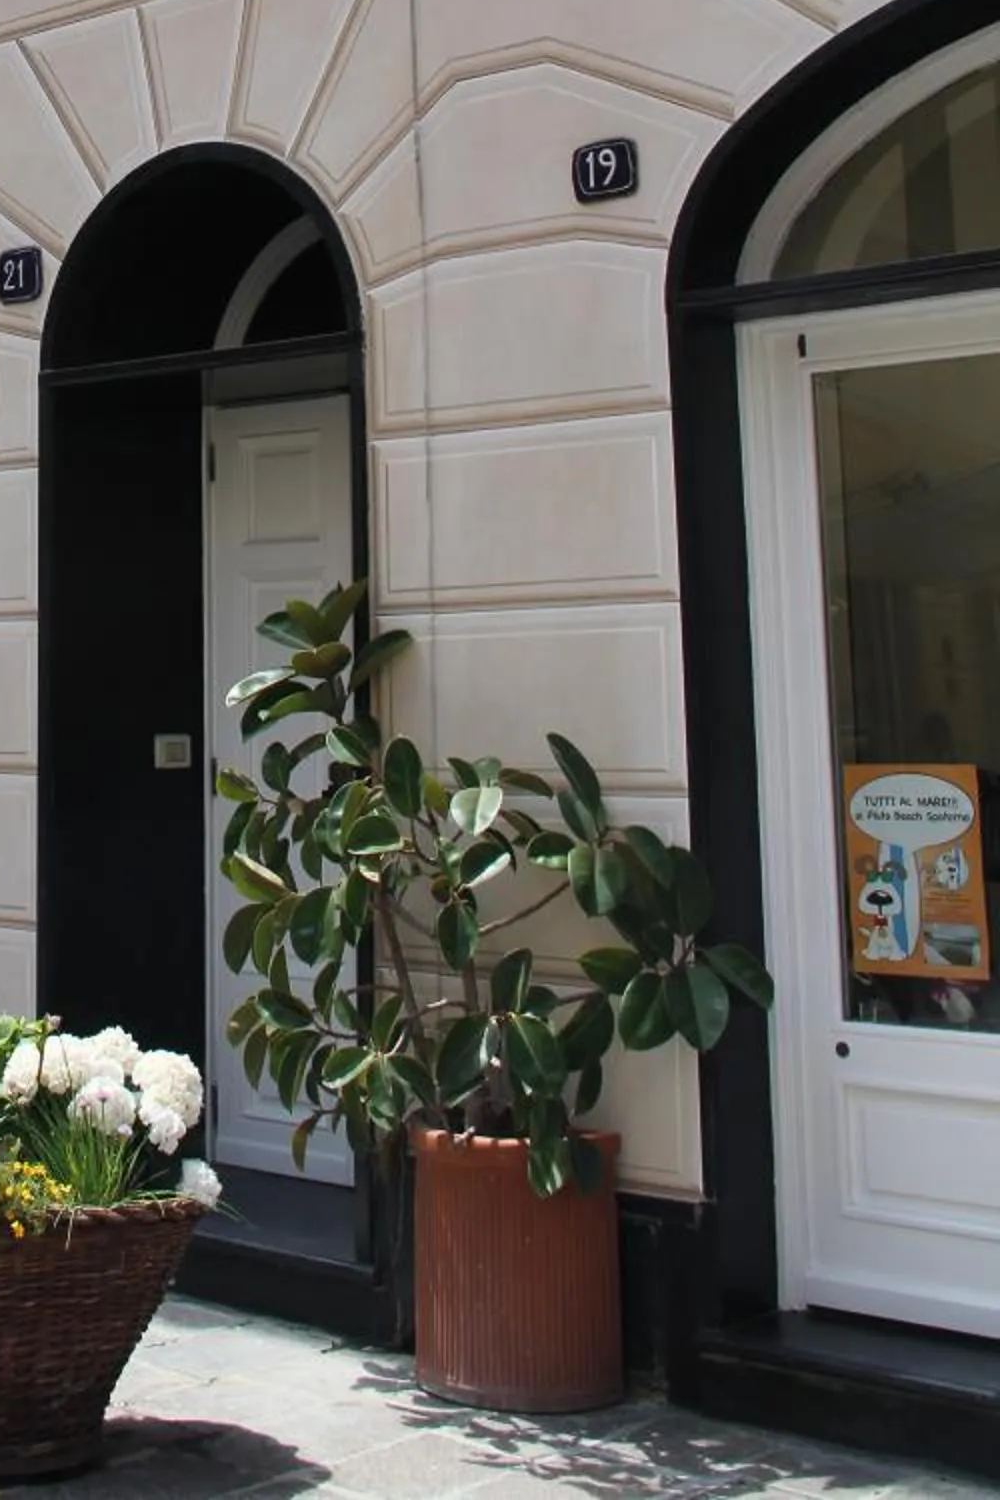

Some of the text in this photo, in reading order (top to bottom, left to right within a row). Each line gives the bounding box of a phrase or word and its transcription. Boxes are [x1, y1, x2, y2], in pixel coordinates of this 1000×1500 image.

[585, 147, 617, 188] 19
[3, 259, 25, 291] 21
[864, 795, 895, 807] TUTTI
[899, 796, 912, 807] AL
